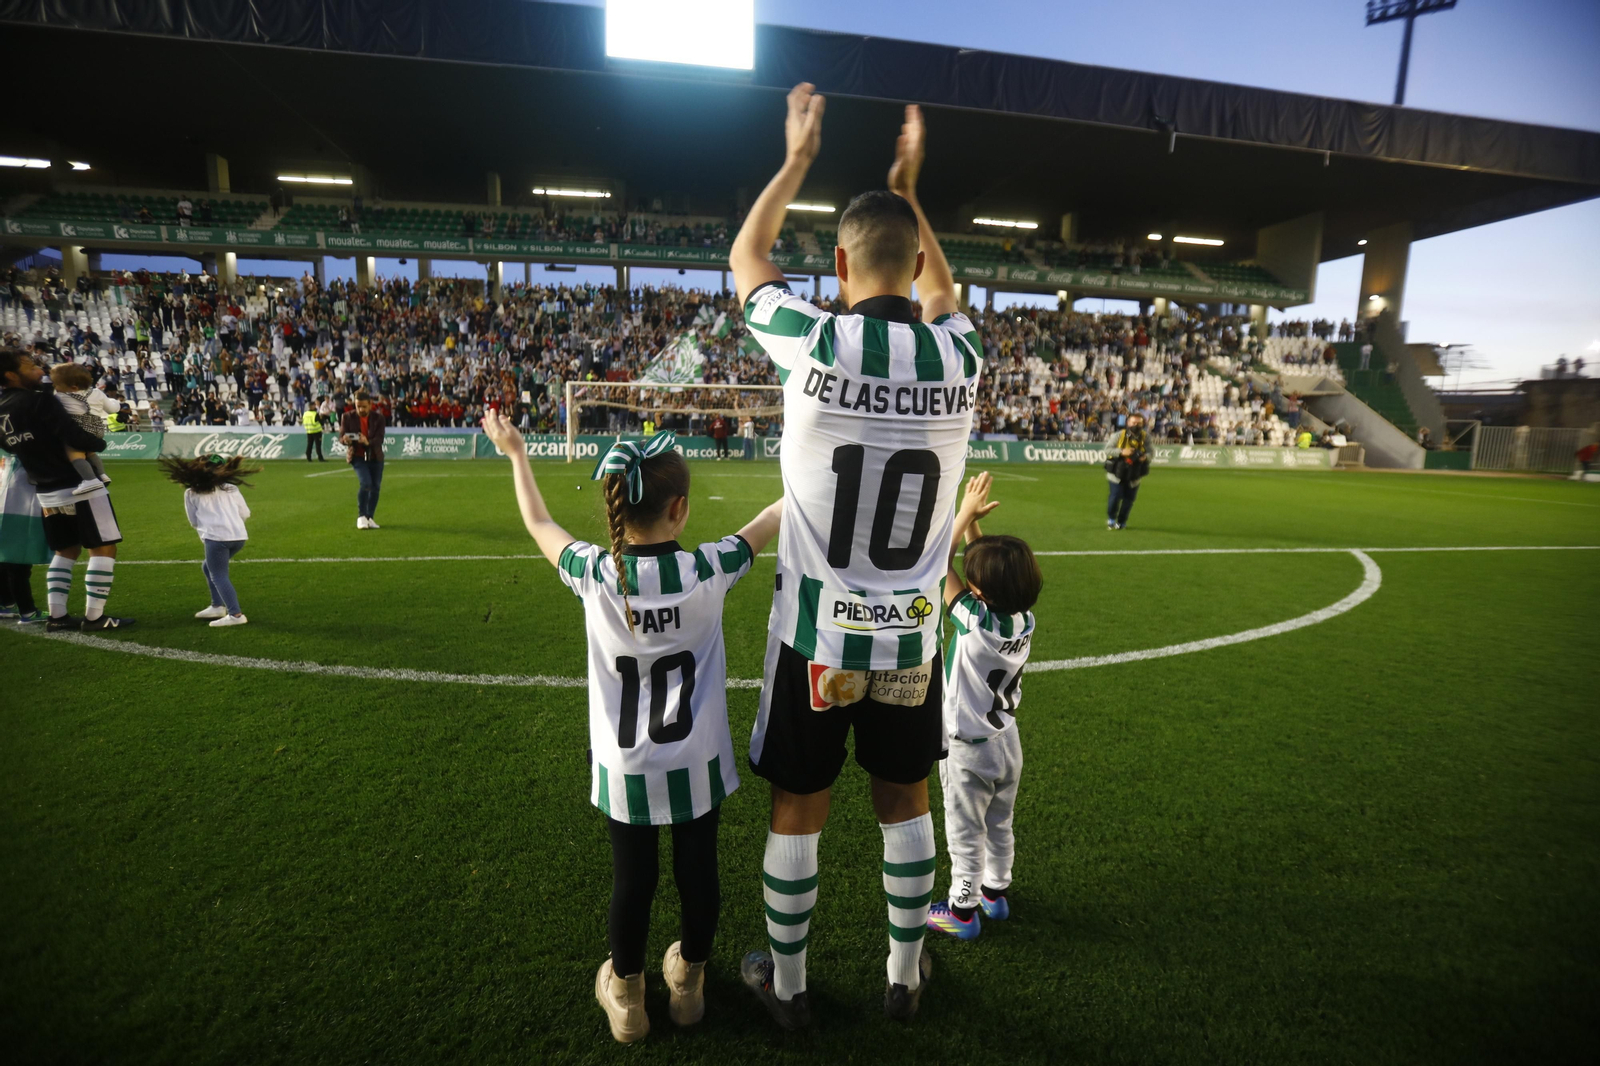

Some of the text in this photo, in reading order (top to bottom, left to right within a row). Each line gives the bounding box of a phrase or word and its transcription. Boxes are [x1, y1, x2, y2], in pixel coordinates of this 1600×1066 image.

[803, 367, 975, 416] DE LAS CUEVAS
[194, 433, 288, 459] Coca-Cola
[686, 449, 698, 458] DE
[1024, 444, 1107, 464] Cruzcampo
[827, 444, 942, 571] 10
[625, 606, 681, 634] PAPI
[616, 650, 696, 749] 10
